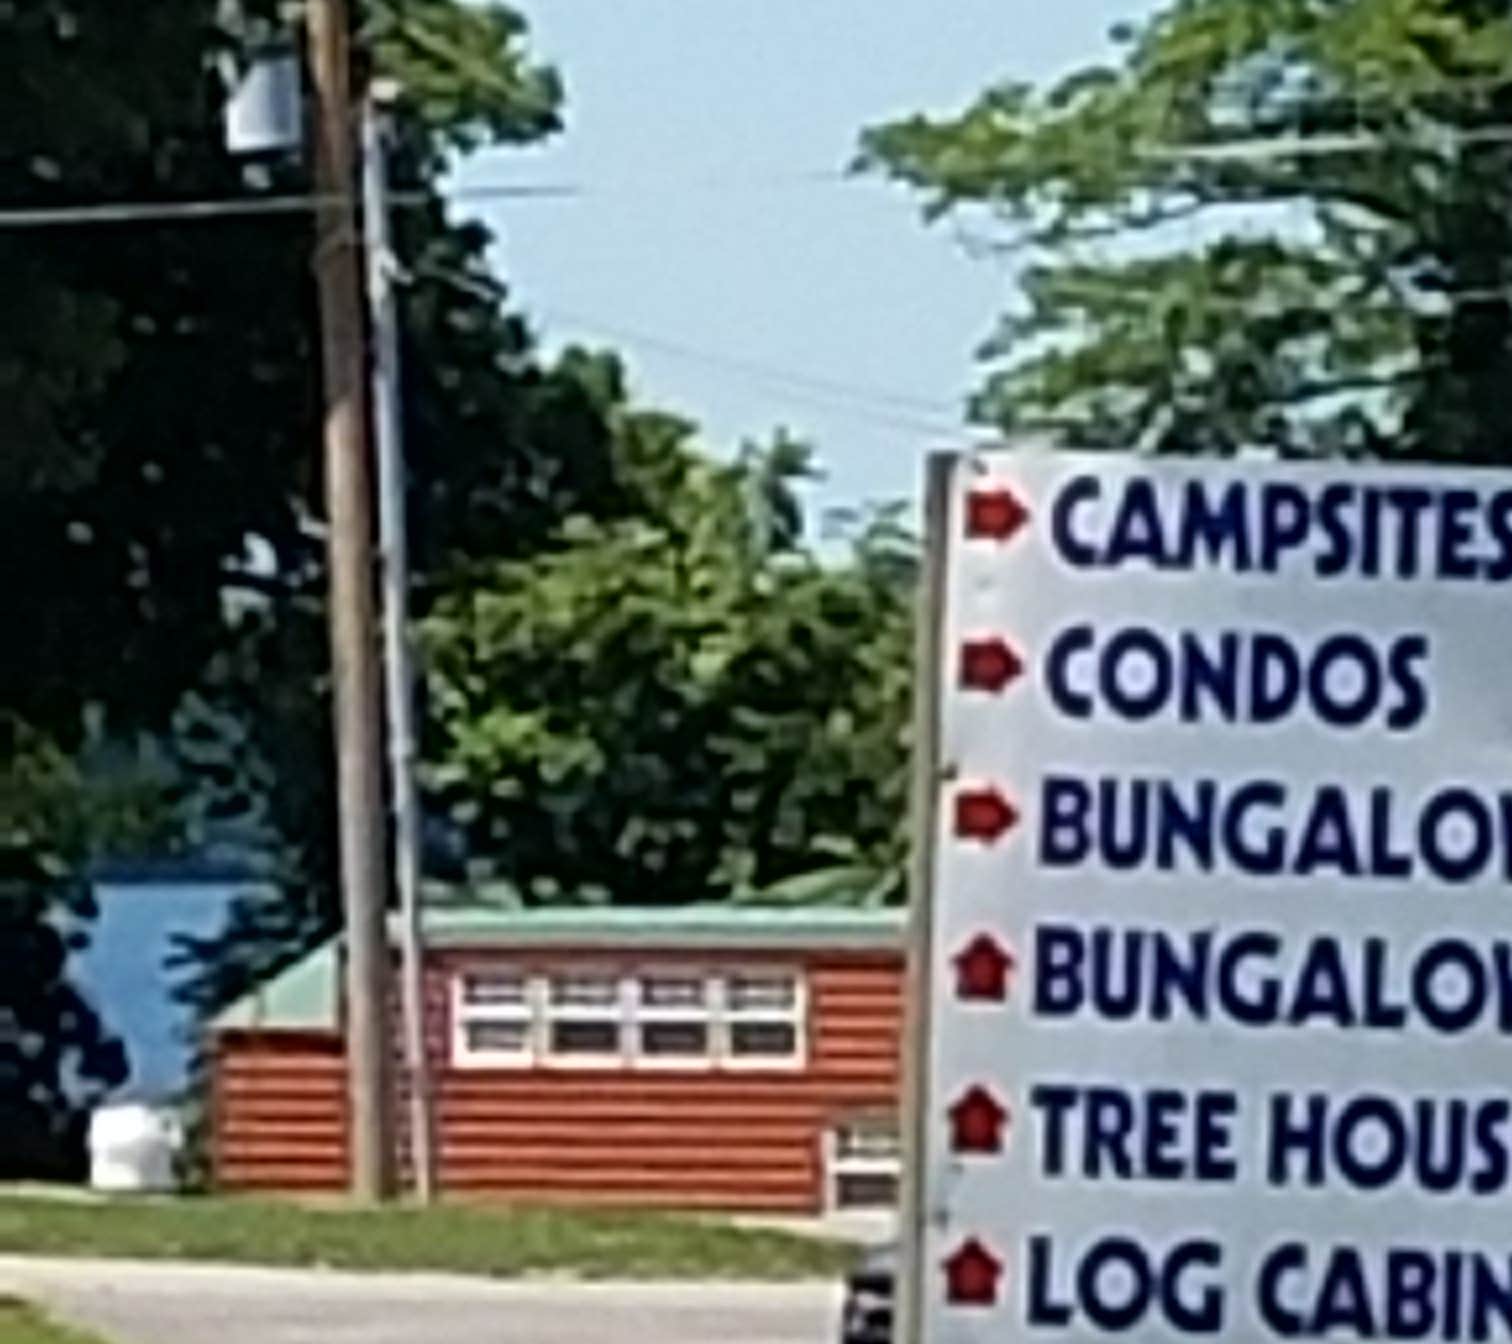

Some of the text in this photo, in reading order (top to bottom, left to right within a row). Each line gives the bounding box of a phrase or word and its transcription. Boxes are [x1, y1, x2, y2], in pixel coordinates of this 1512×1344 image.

[1045, 626, 1429, 730] CONDOS
[1031, 1085, 1237, 1182] TREE
[1026, 1236, 1225, 1334] LOG
